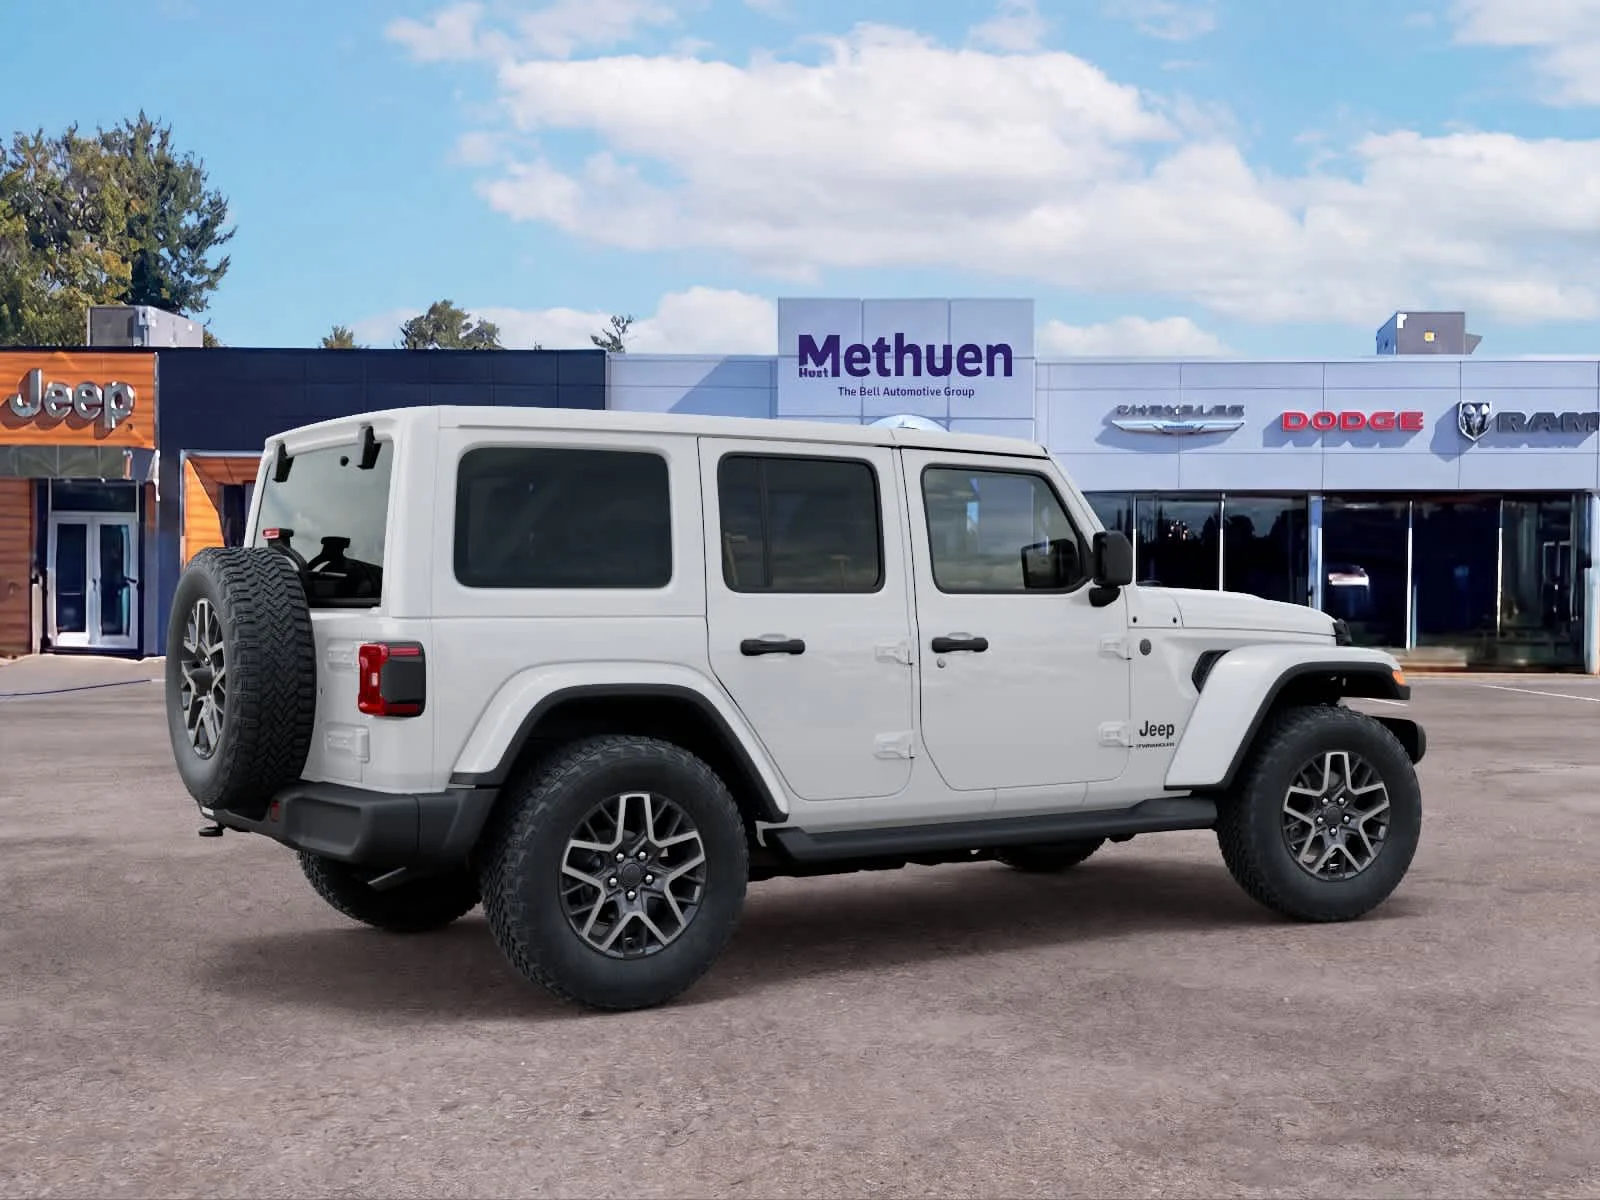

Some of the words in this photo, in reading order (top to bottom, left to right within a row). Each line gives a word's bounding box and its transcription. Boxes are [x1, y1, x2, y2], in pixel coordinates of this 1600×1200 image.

[798, 332, 1012, 377] Methuen
[9, 368, 135, 429] Jeep
[838, 386, 856, 396] The
[859, 386, 879, 396] Bell
[883, 386, 941, 396] Automotive
[944, 386, 975, 398] Group
[1283, 411, 1424, 431] DODGE
[1498, 411, 1600, 432] RAM
[1139, 720, 1175, 739] Jeep
